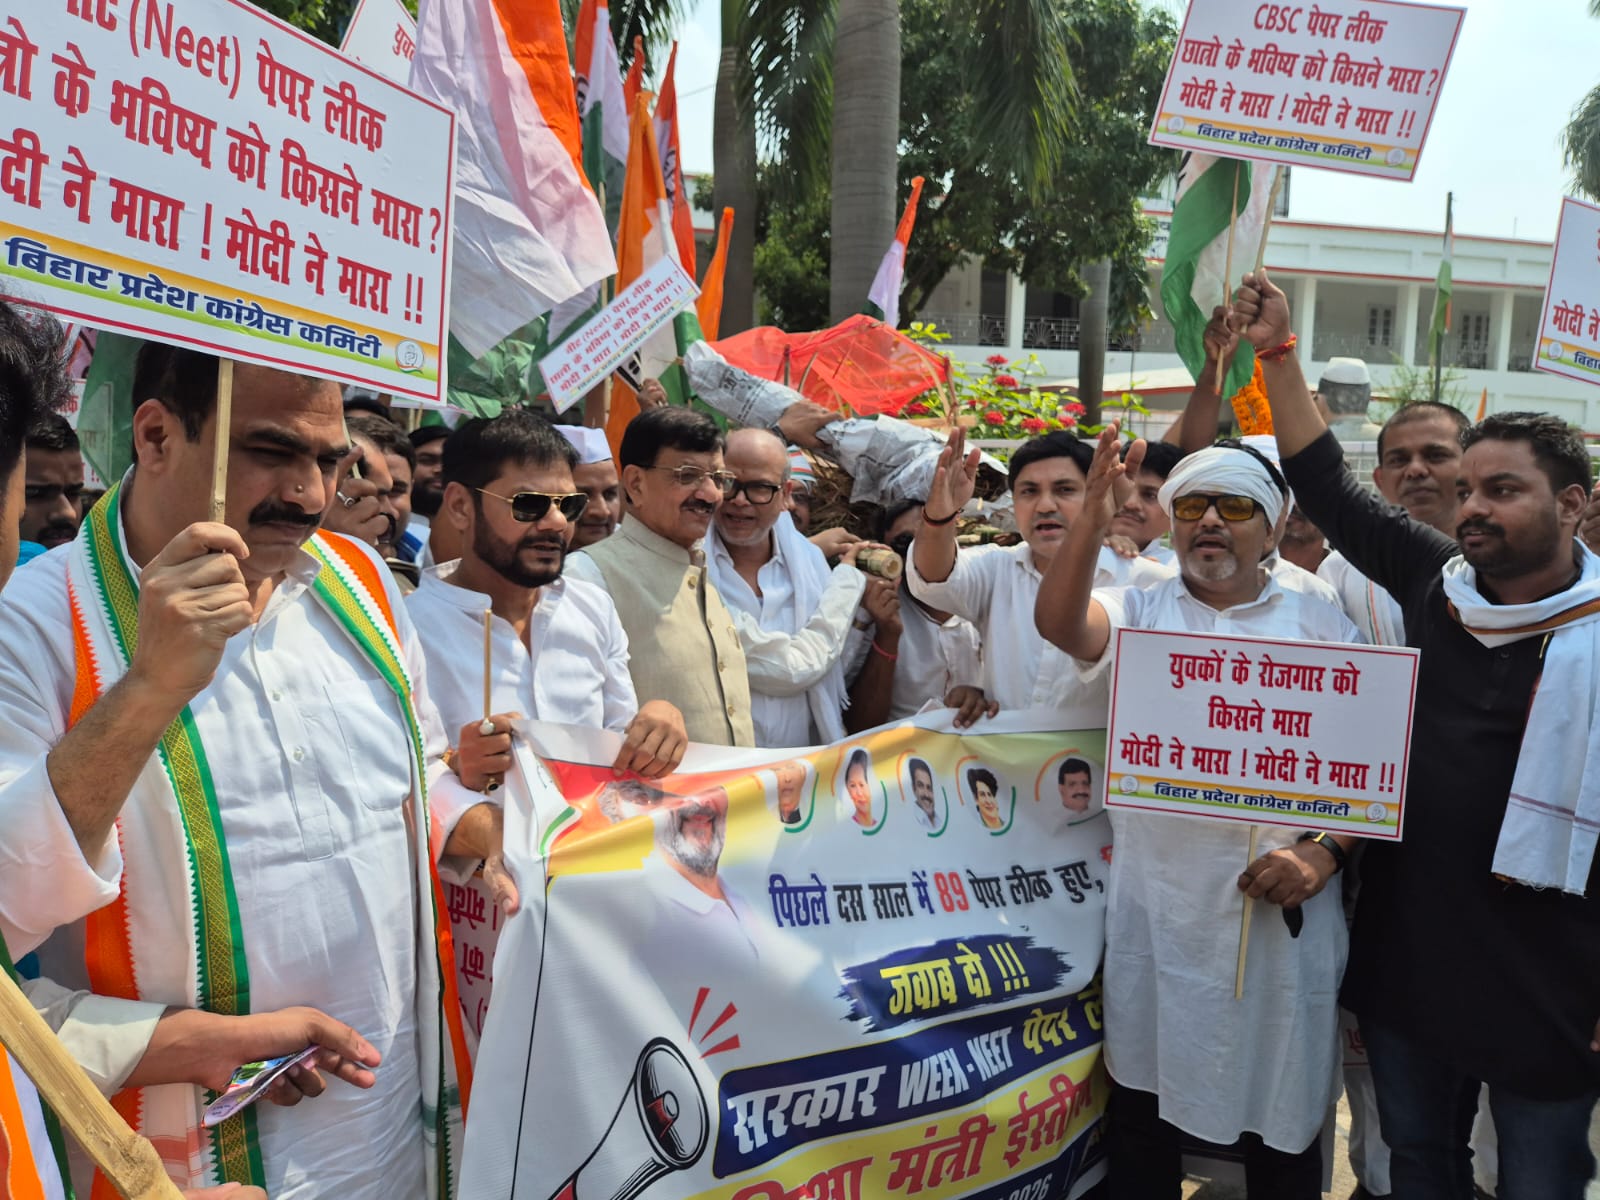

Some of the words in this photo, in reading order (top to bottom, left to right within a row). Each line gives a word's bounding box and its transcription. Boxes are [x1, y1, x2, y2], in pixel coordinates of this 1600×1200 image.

[1254, 3, 1303, 34] CBSC
[1307, 4, 1341, 39] पेपर
[1344, 10, 1388, 44] लीक
[130, 0, 241, 100] (Neet)
[257, 38, 314, 122] पेपर
[323, 81, 386, 152] लीक
[1225, 38, 1245, 70] के
[1247, 43, 1300, 78] भविष्य
[1301, 50, 1329, 82] को
[1330, 52, 1384, 89] किसने
[51, 41, 96, 119] के
[110, 76, 217, 169] भविष्य
[226, 121, 270, 191] को
[280, 138, 363, 225] किसने
[1179, 76, 1218, 111] मोदी
[1220, 81, 1237, 113] ने
[1238, 91, 1275, 119] मारा
[1291, 92, 1333, 128] मोदी
[1333, 97, 1353, 129] ने
[1355, 107, 1394, 135] मारा
[1197, 123, 1236, 141] बिहार
[1237, 130, 1272, 147] प्रदेश
[1274, 136, 1320, 153] कांग्रेस
[1322, 142, 1372, 161] कमिटी
[62, 145, 97, 224] ने
[109, 177, 185, 251] मारा
[225, 208, 295, 285] मोदी
[303, 232, 328, 296] ने
[337, 256, 392, 314] मारा
[5, 237, 113, 290] बिहार
[118, 271, 198, 313] प्रदेश
[203, 293, 293, 337] कांग्रेस
[297, 320, 382, 359] कमिटी
[1552, 300, 1585, 337] मोदी
[1574, 351, 1600, 370] बिहा
[1169, 649, 1226, 688] युवकों
[1231, 652, 1252, 685] के
[1258, 654, 1327, 693] रोजगार
[1331, 661, 1361, 695] को
[1208, 695, 1265, 733] किसने
[1272, 709, 1313, 738] मारा
[1120, 733, 1163, 767] मोदी
[1169, 737, 1185, 770] ने
[1192, 747, 1232, 775] मारा
[1254, 747, 1299, 782] मोदी
[1305, 752, 1322, 785] ने
[1329, 761, 1370, 791] मारा
[1153, 782, 1199, 799] बिहार
[1201, 788, 1239, 805] प्रदेश
[1243, 793, 1294, 811] कांग्रेस
[1296, 799, 1351, 817] कमिटी
[768, 873, 831, 928] पिछले
[833, 884, 867, 922] दस
[869, 882, 914, 920] साल
[912, 871, 935, 914] में
[934, 871, 969, 912] 89
[966, 868, 1007, 909] पेपर
[1005, 865, 1053, 905] लीक
[880, 957, 957, 1016] जवाब
[955, 942, 992, 997] दो
[727, 1066, 887, 1154] सरकार
[1023, 1007, 1077, 1055] पेपर
